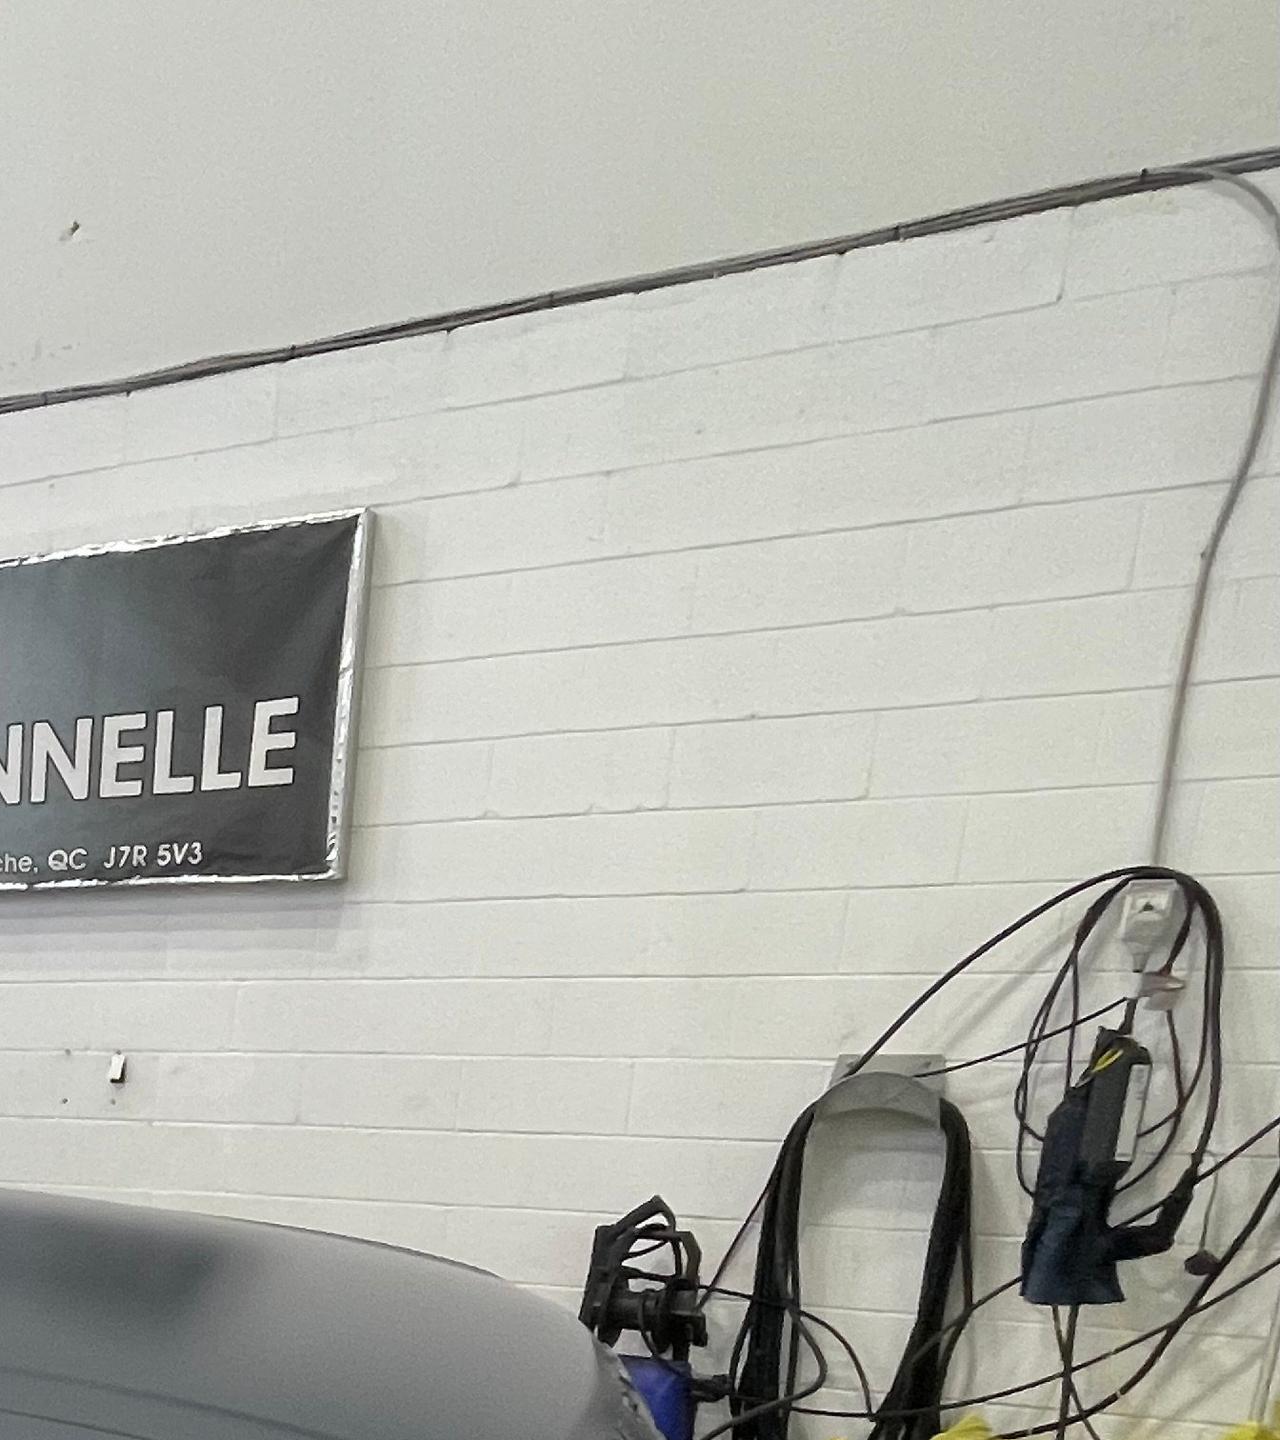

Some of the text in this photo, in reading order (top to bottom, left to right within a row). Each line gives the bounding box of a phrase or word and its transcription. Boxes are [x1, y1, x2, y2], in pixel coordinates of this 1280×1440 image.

[47, 848, 88, 872] QC
[103, 844, 147, 869] J7R
[156, 842, 203, 867] 5V3
